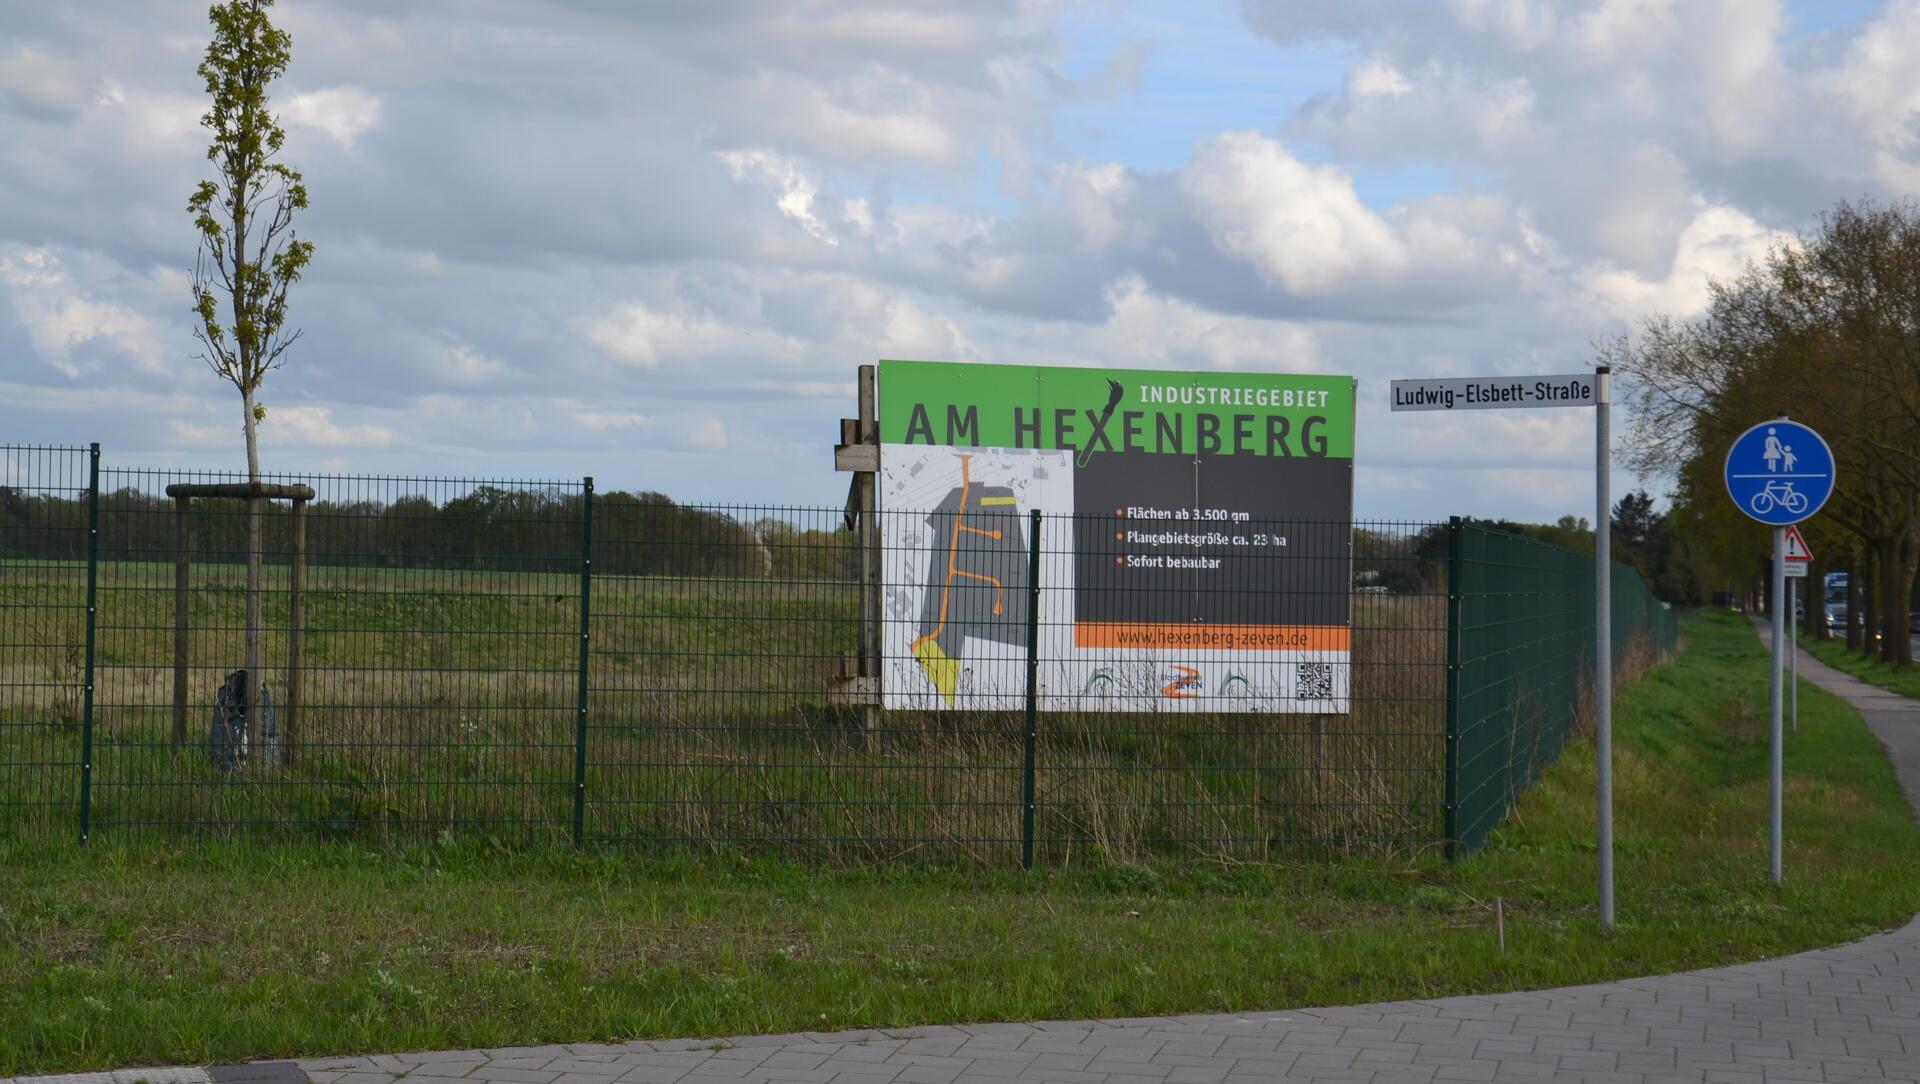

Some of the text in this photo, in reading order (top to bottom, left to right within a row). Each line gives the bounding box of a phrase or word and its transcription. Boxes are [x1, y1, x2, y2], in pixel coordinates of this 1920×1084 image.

[1140, 385, 1328, 407] INDUSTRIEGEBIET
[1395, 381, 1591, 408] Ludwig-Elsbett-Straße
[904, 403, 1329, 459] AM HEXENBERG
[1127, 507, 1250, 524] Flächen ab 3.500 qm
[1127, 531, 1229, 547] Plangebietsgröße
[1232, 535, 1249, 546] ca.
[1126, 555, 1222, 569] Sofort bebaubar
[1117, 629, 1308, 648] www.hexenberg-zeven.de
